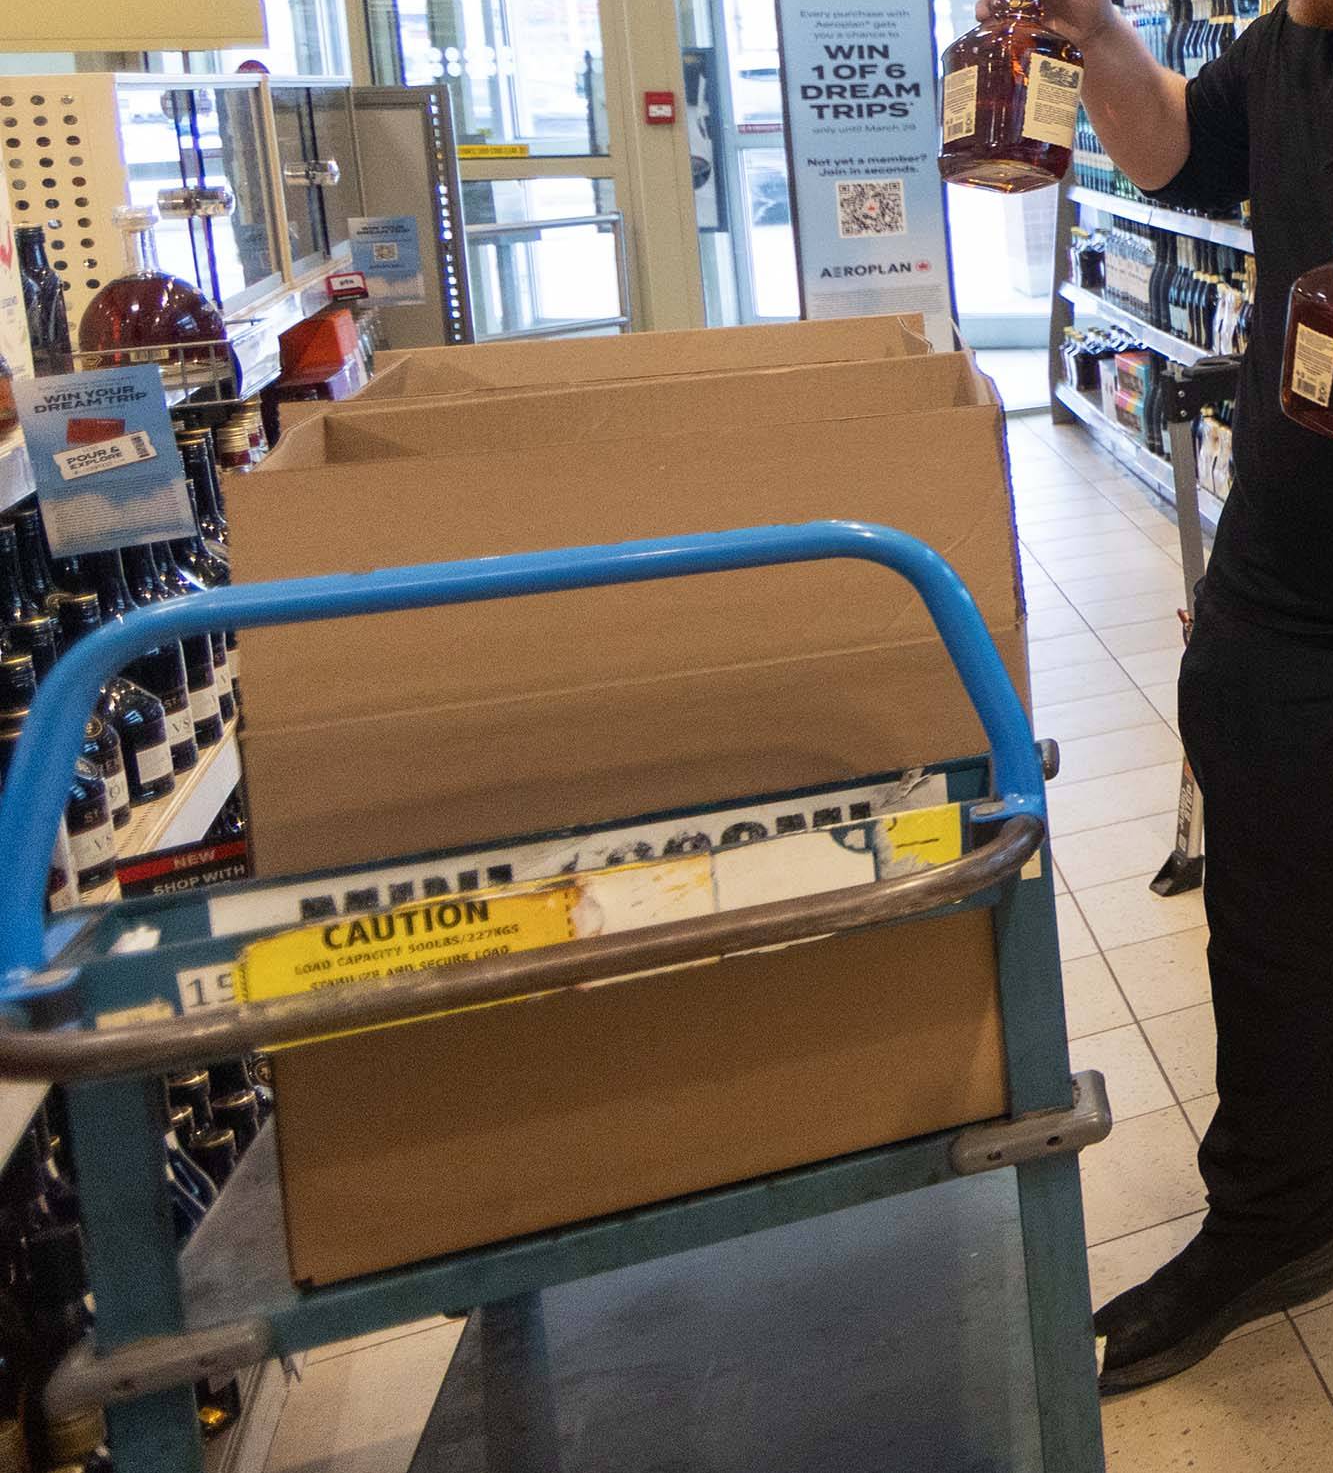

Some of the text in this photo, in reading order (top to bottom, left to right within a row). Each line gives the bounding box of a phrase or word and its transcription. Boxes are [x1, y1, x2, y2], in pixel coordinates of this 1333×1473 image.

[824, 44, 890, 60] WIN
[812, 63, 906, 80] 1 OF 6
[801, 83, 921, 100] DREAM
[820, 263, 912, 278] AEROPLAN
[34, 391, 148, 414] DREAM TRIP
[43, 385, 135, 404] WIN YOUR
[66, 448, 107, 465] POUR
[69, 451, 123, 471] EXPLORE
[172, 849, 217, 868] NEW
[200, 864, 246, 885] WITH
[323, 901, 491, 951] CAUTION
[336, 945, 402, 967] CAPACITY
